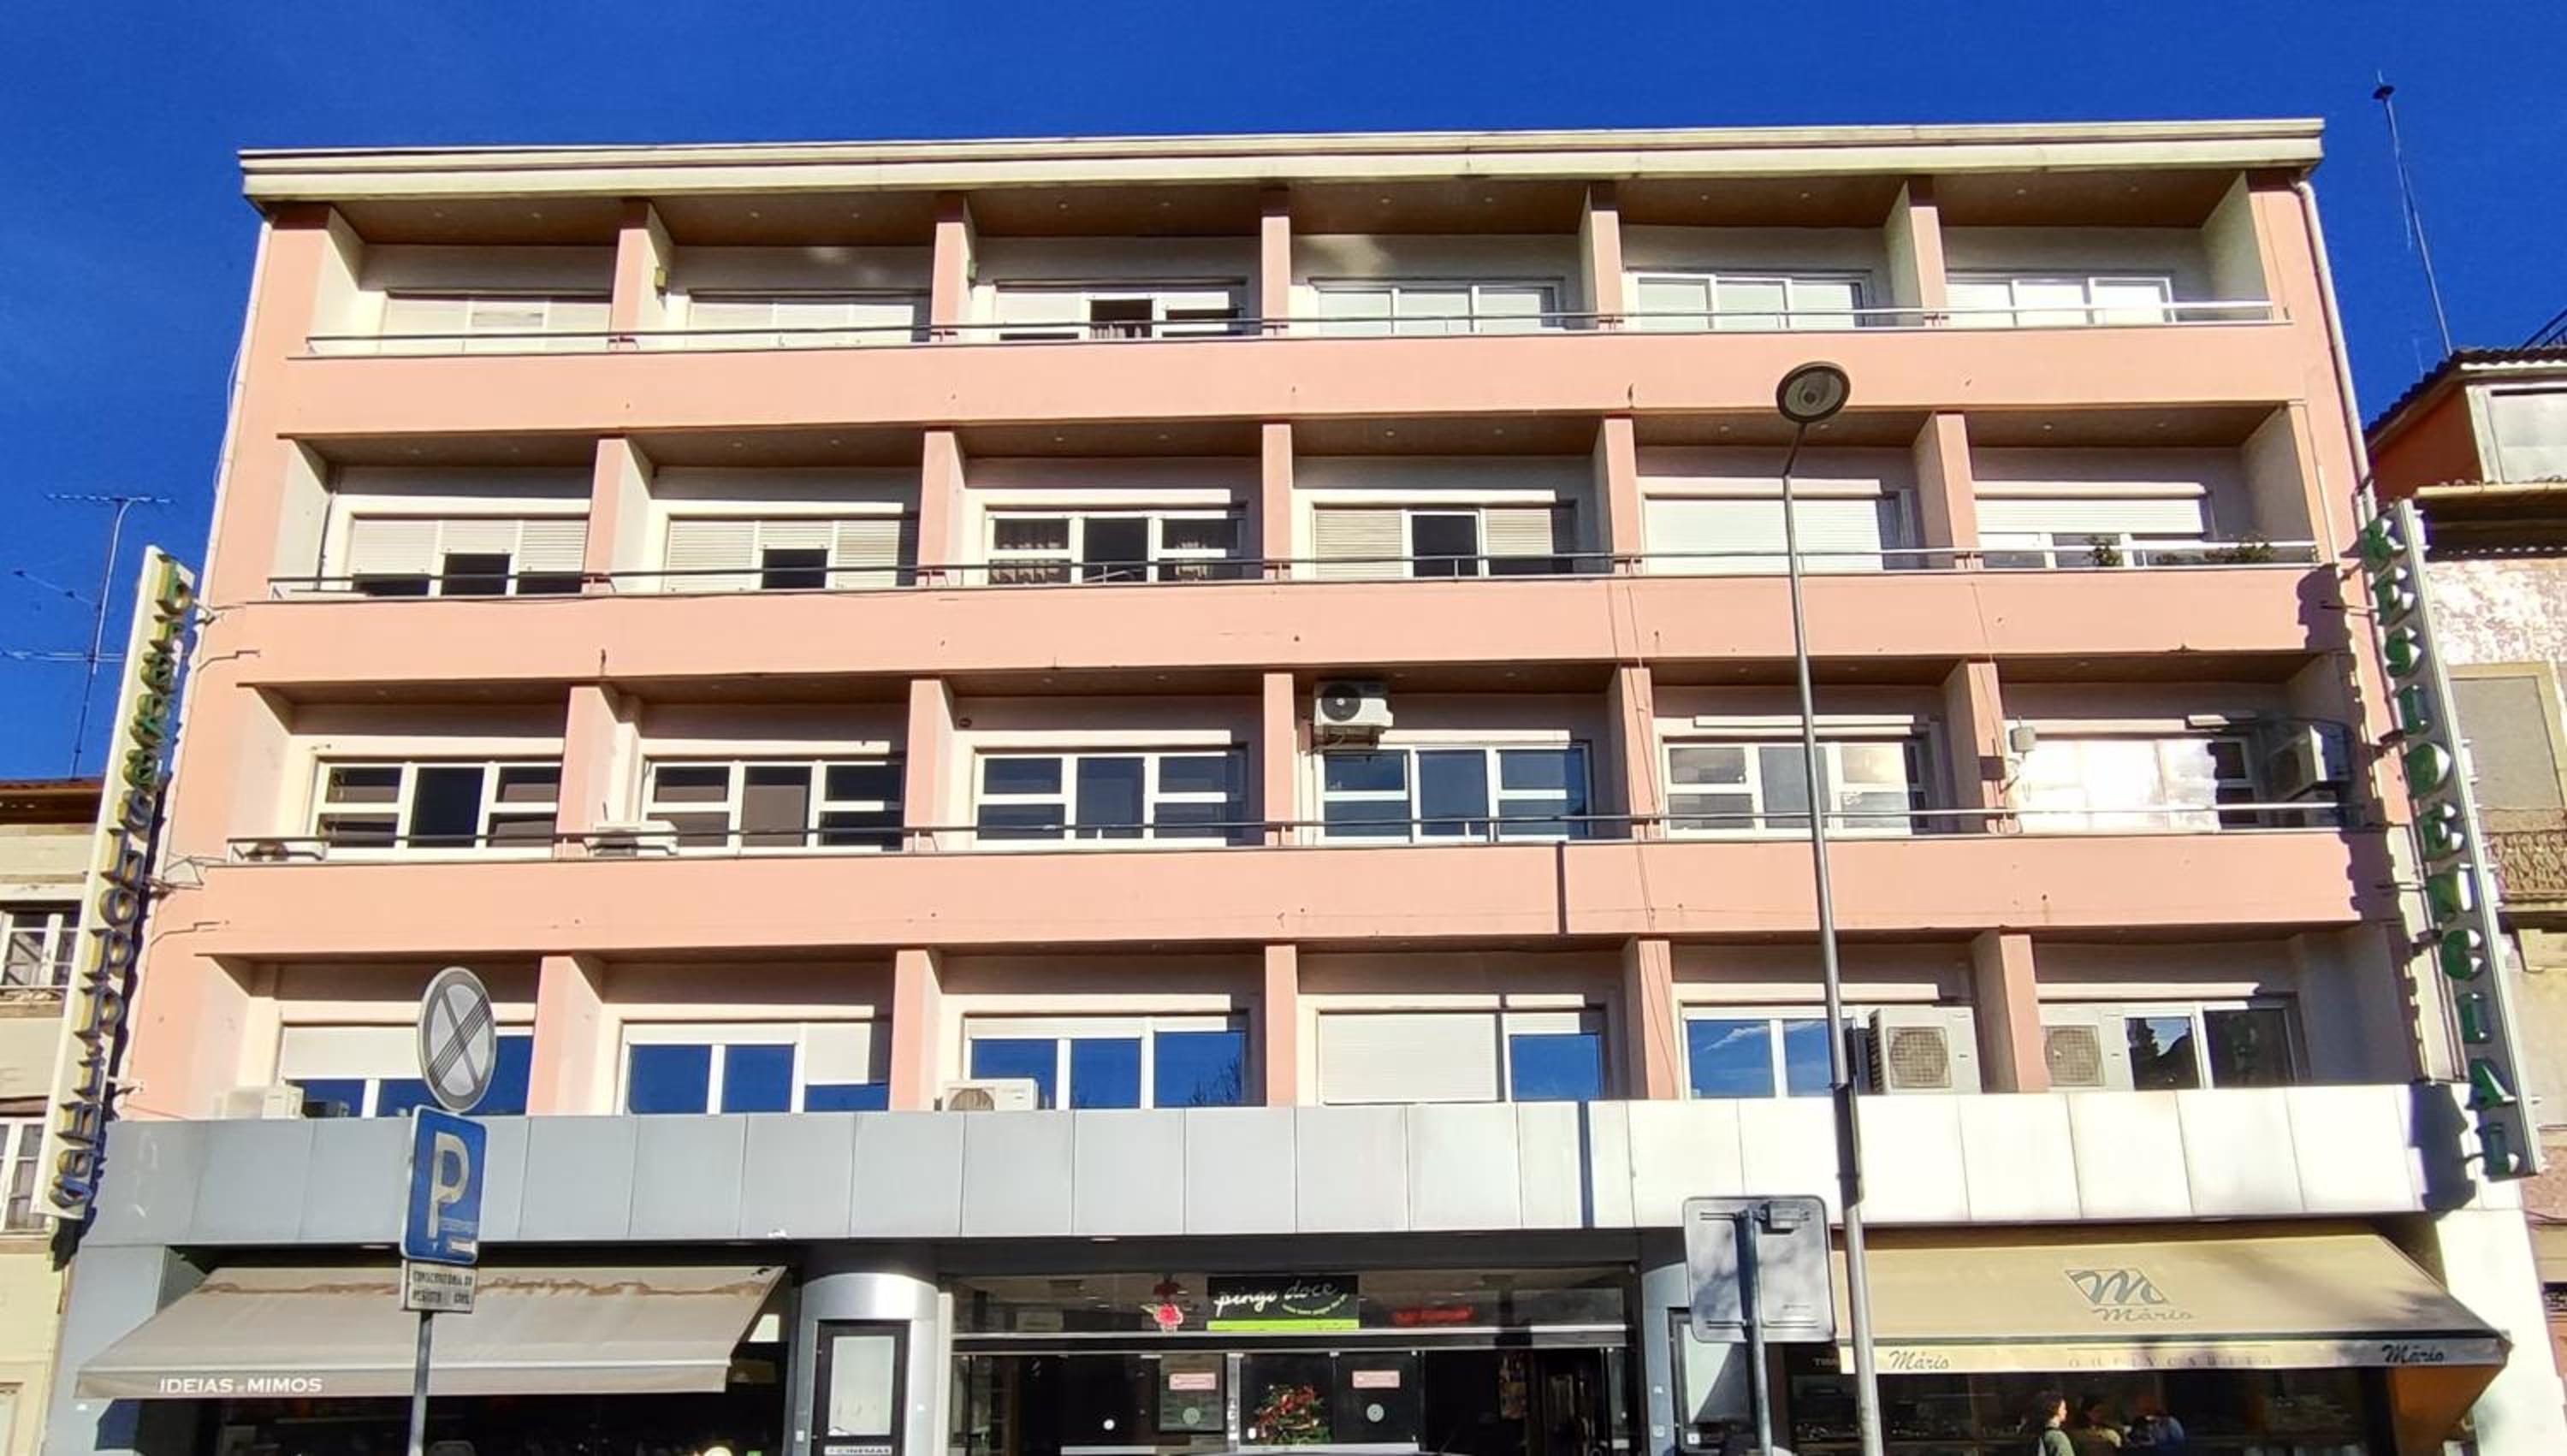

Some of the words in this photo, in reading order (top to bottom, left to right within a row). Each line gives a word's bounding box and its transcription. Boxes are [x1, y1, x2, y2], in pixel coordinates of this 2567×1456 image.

[427, 1131, 470, 1240] P
[1213, 1287, 1278, 1317] pingo
[1283, 1279, 1337, 1299] doce
[2092, 1307, 2192, 1322] Mário
[1888, 1350, 1950, 1370] Mário
[2382, 1344, 2445, 1364] Mário
[159, 1378, 234, 1394] IDEIAS
[247, 1377, 323, 1394] MIMOS
